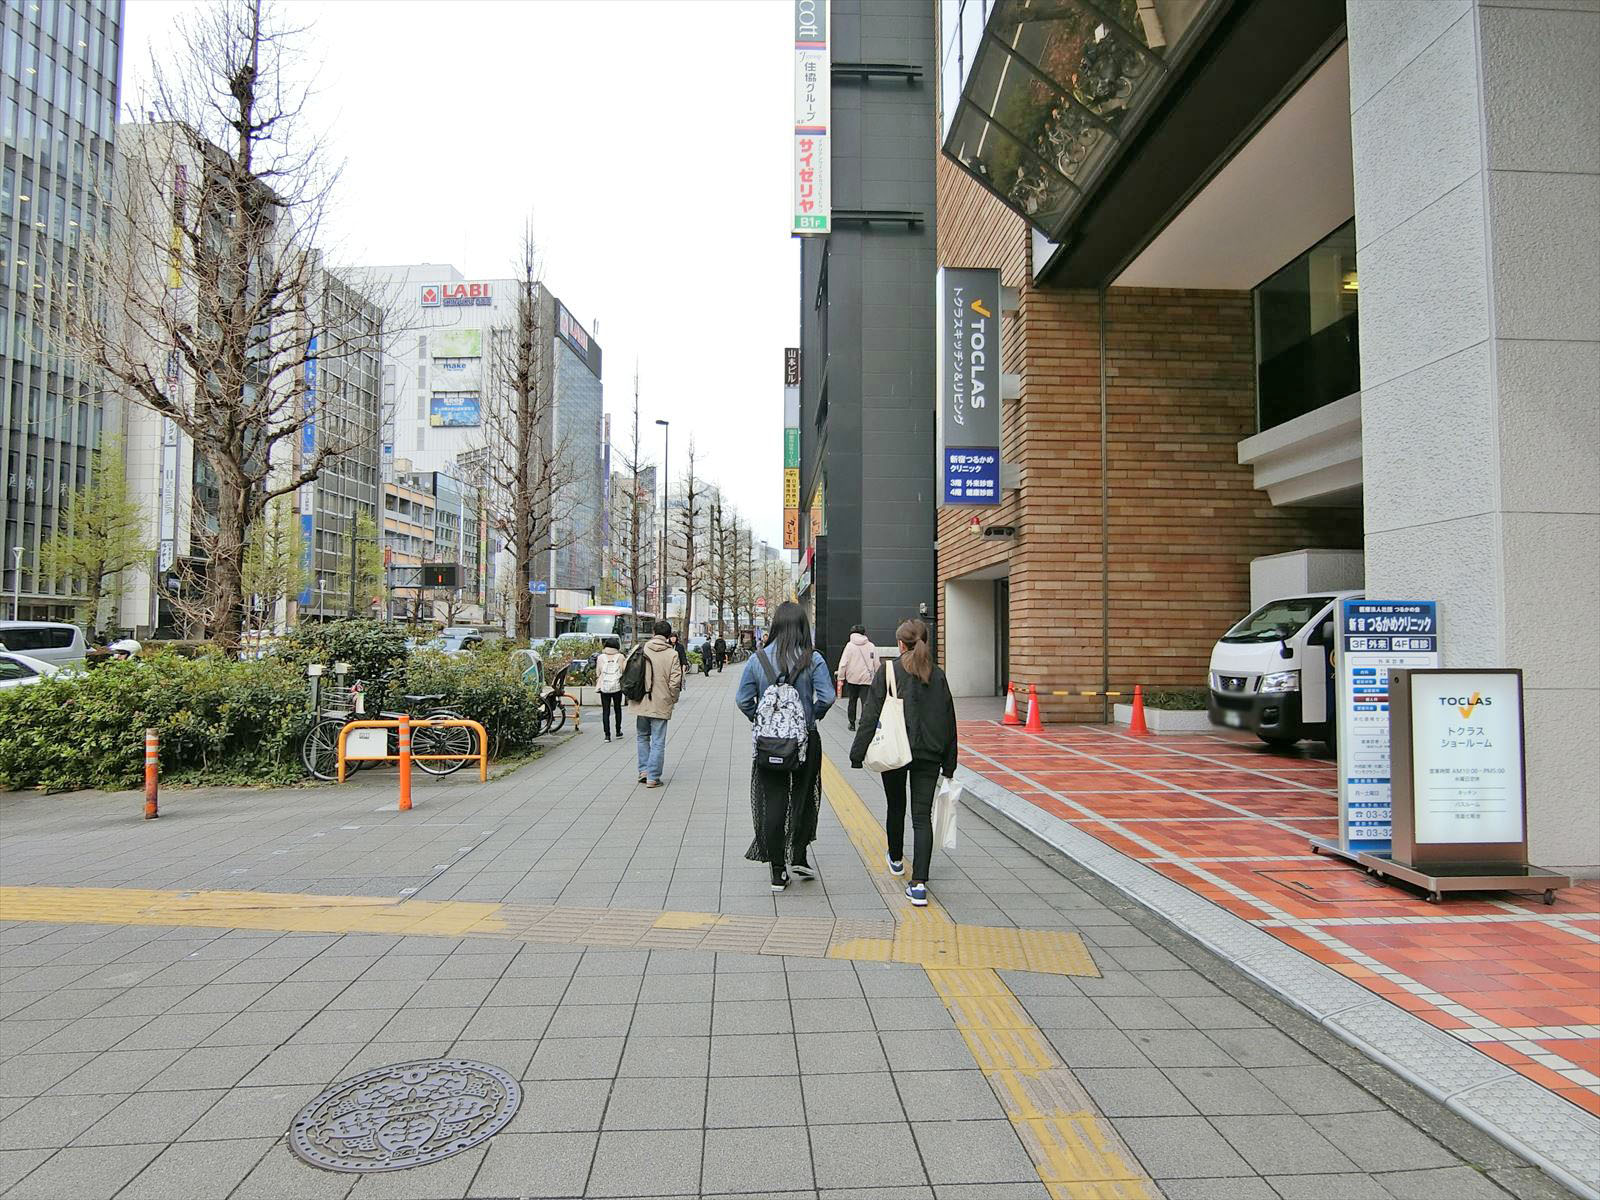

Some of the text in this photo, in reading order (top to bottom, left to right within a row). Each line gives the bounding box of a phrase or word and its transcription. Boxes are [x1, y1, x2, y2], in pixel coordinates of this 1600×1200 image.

[804, 61, 817, 122] 住協グループ
[800, 139, 814, 213] サイゼリヤ
[800, 216, 821, 228] B1F
[442, 283, 489, 298] LABI
[953, 287, 964, 426] トクラスキッチン&リビング
[787, 348, 797, 384] 山本ビル
[971, 318, 985, 409] TOCLAS
[950, 454, 994, 464] 新宿つるかめ
[950, 465, 982, 473] クリニック
[1367, 616, 1432, 632] つるかめクリニック
[1352, 639, 1366, 649] 3F
[1393, 639, 1408, 649] 4F
[1439, 697, 1493, 706] TOCLAS
[1448, 727, 1486, 737] トクラス
[1440, 739, 1493, 749] ショールーム
